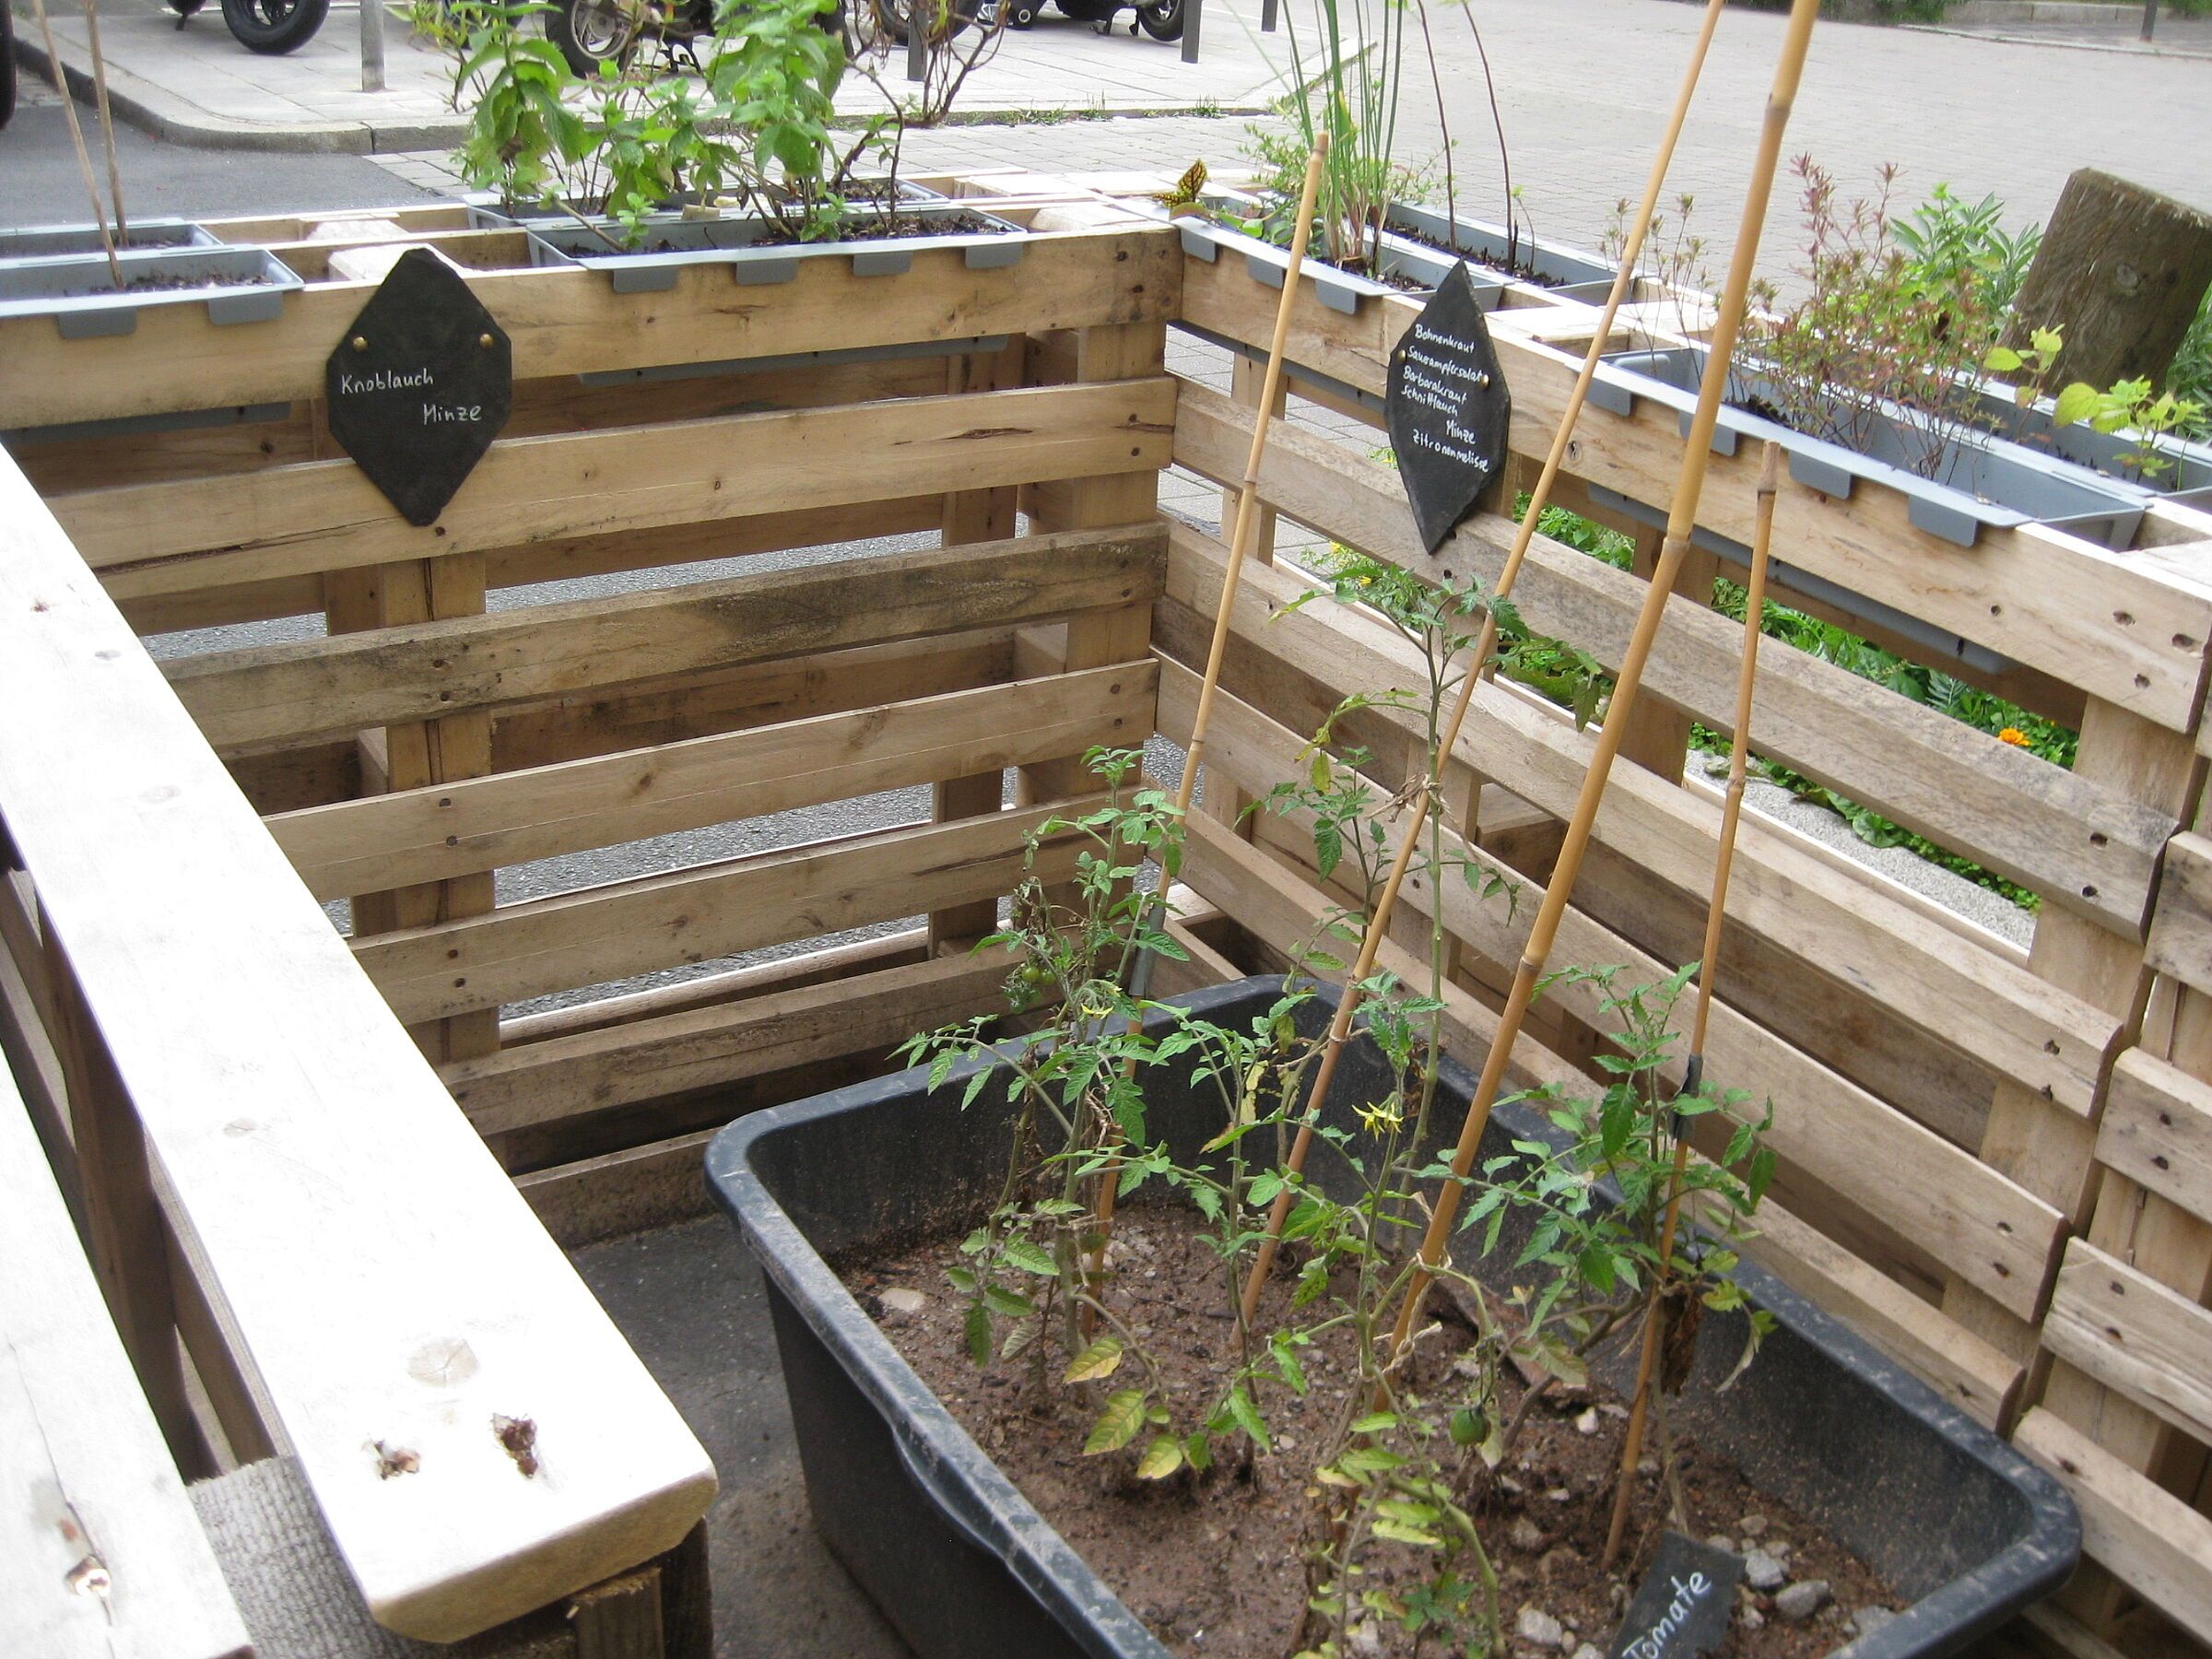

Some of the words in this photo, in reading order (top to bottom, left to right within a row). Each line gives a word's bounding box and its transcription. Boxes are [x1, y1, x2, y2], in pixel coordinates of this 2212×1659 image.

[1415, 324, 1475, 353] Bohnenkraut
[341, 368, 433, 394] Knoblauch
[423, 403, 482, 425] Minze
[1401, 385, 1458, 417] Schnittlauch
[1446, 419, 1476, 444] Minze
[1622, 1571, 1712, 1659] Tomate
